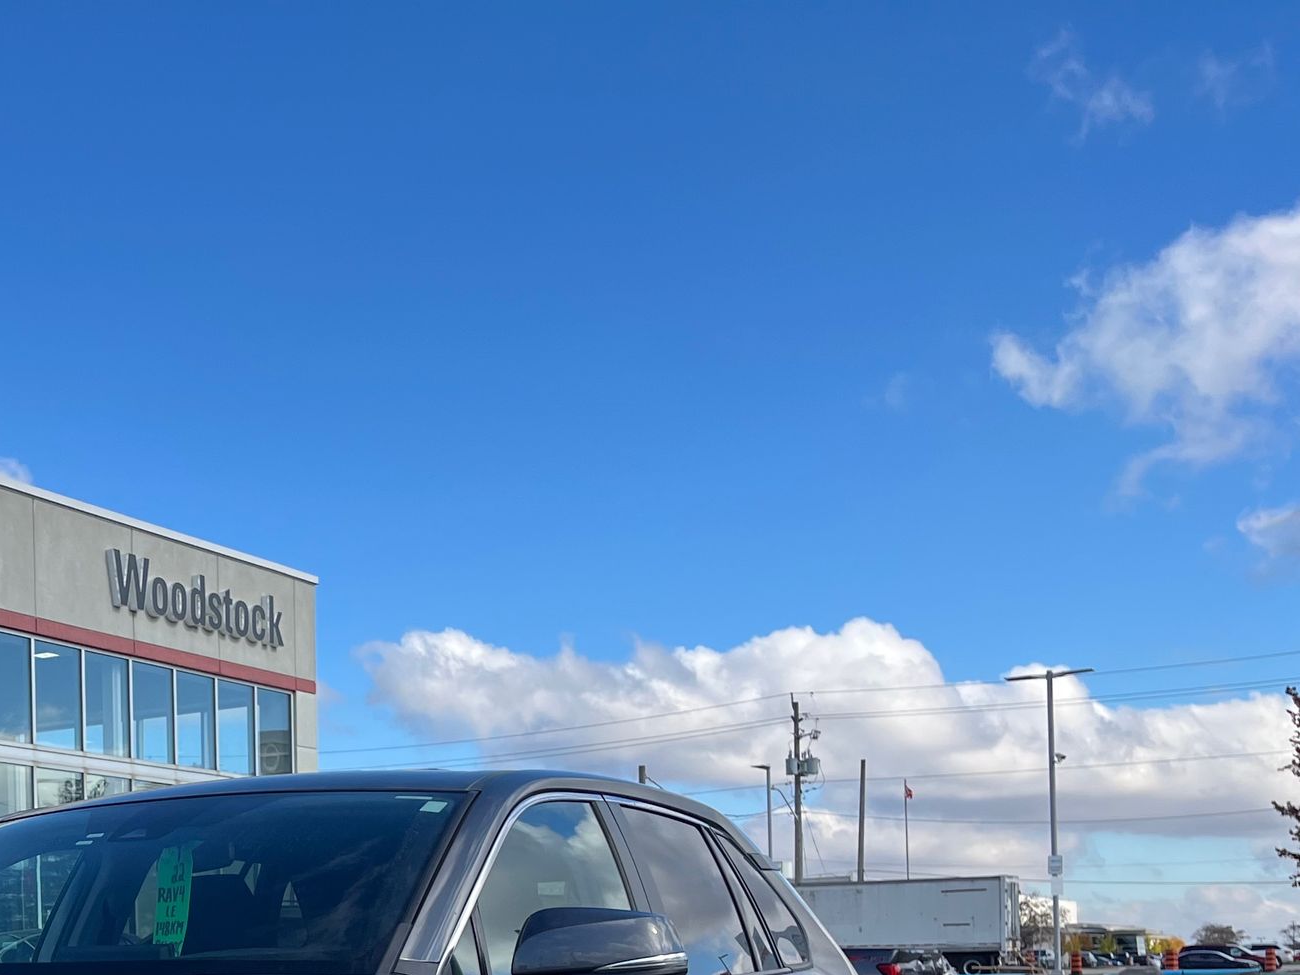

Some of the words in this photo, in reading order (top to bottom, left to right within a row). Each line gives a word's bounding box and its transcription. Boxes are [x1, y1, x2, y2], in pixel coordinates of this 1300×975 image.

[106, 549, 284, 650] Woodstock
[157, 884, 185, 903] RAV4
[165, 905, 177, 918] LE
